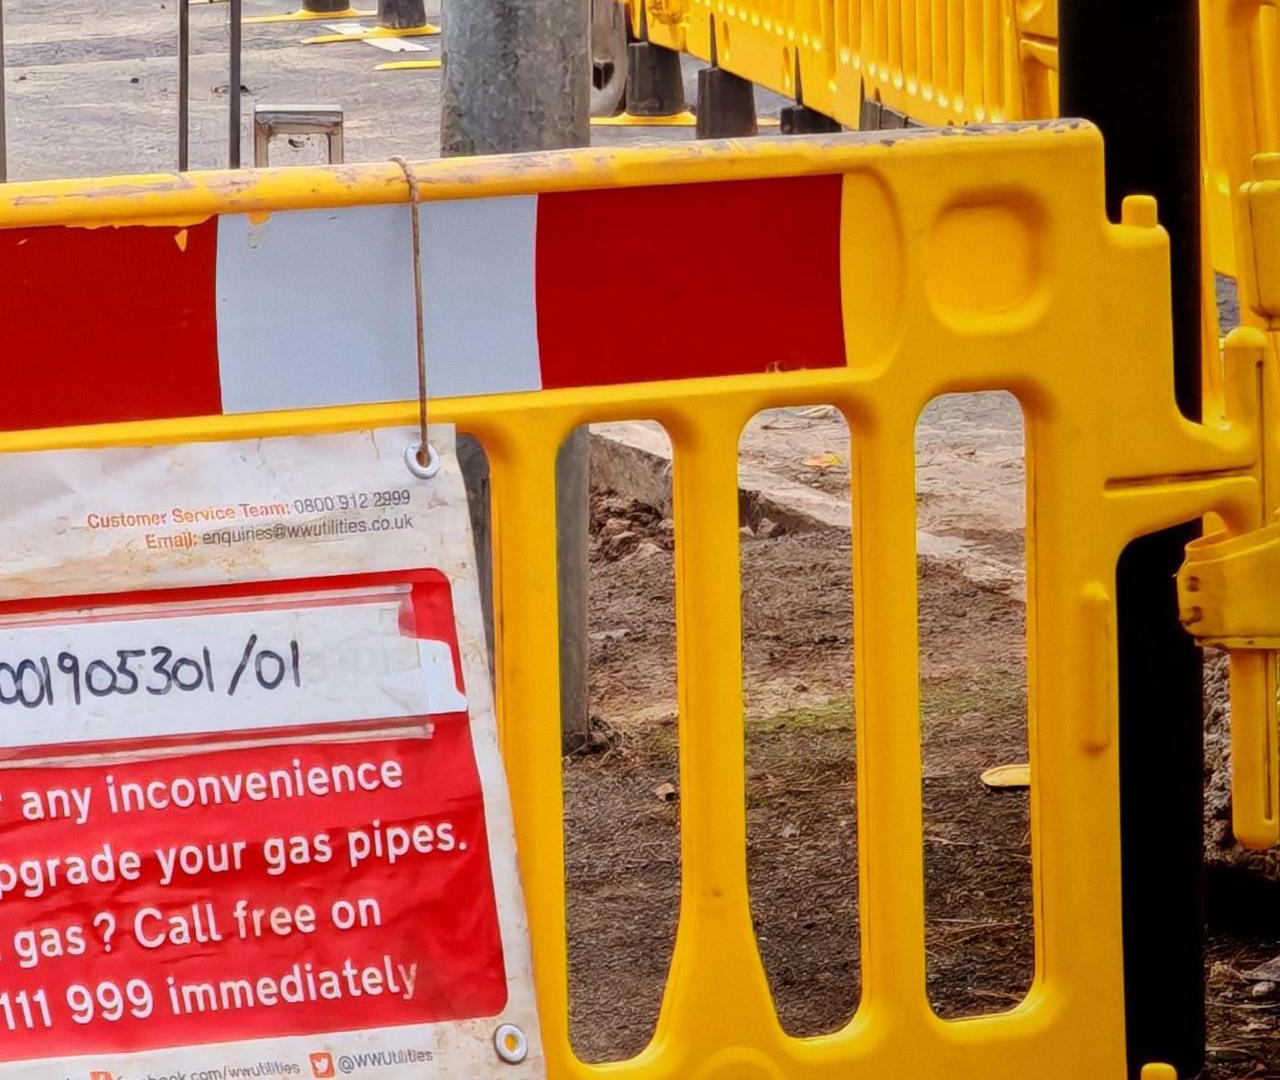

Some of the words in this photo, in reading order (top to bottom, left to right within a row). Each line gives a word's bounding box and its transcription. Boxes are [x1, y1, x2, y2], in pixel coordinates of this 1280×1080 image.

[87, 511, 168, 530] Customer
[172, 506, 236, 525] Service
[239, 502, 290, 519] Team:
[293, 496, 335, 514] 0800
[339, 493, 368, 511] 912
[145, 531, 198, 551] Email:
[202, 514, 414, 549] enquiries@wwutilities.co.uk
[20, 785, 92, 826] any
[105, 758, 404, 814] inconvenience
[154, 838, 247, 886] your
[263, 832, 334, 876] gas
[346, 819, 469, 869] pipes.
[133, 902, 223, 949] Call
[233, 899, 316, 940] free
[331, 895, 382, 931] on
[65, 977, 154, 1025] 999
[166, 954, 418, 1016] immediately
